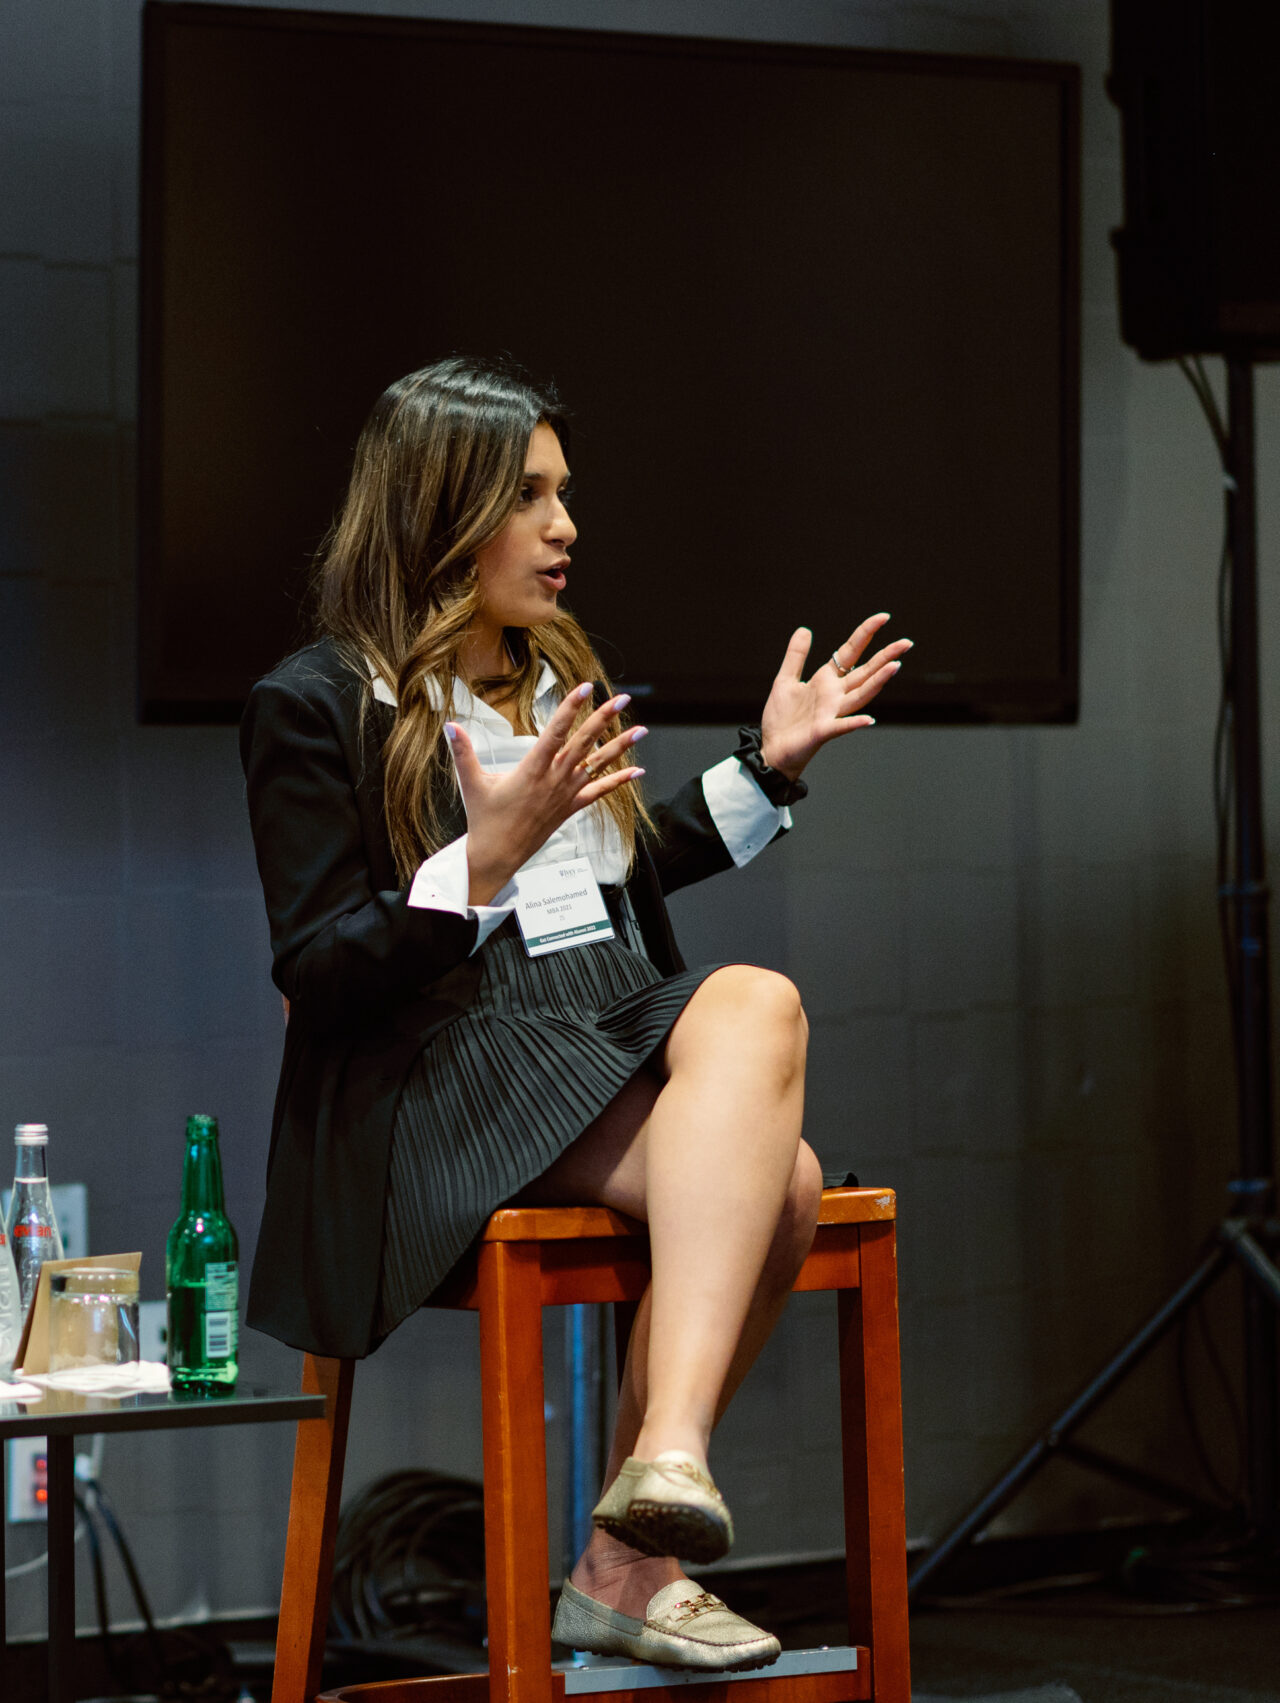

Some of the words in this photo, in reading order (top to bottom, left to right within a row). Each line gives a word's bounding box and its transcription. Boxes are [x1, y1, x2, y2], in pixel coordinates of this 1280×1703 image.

[525, 901, 542, 910] Alina
[542, 889, 588, 905] Salemohamed
[14, 1225, 52, 1238] evian
